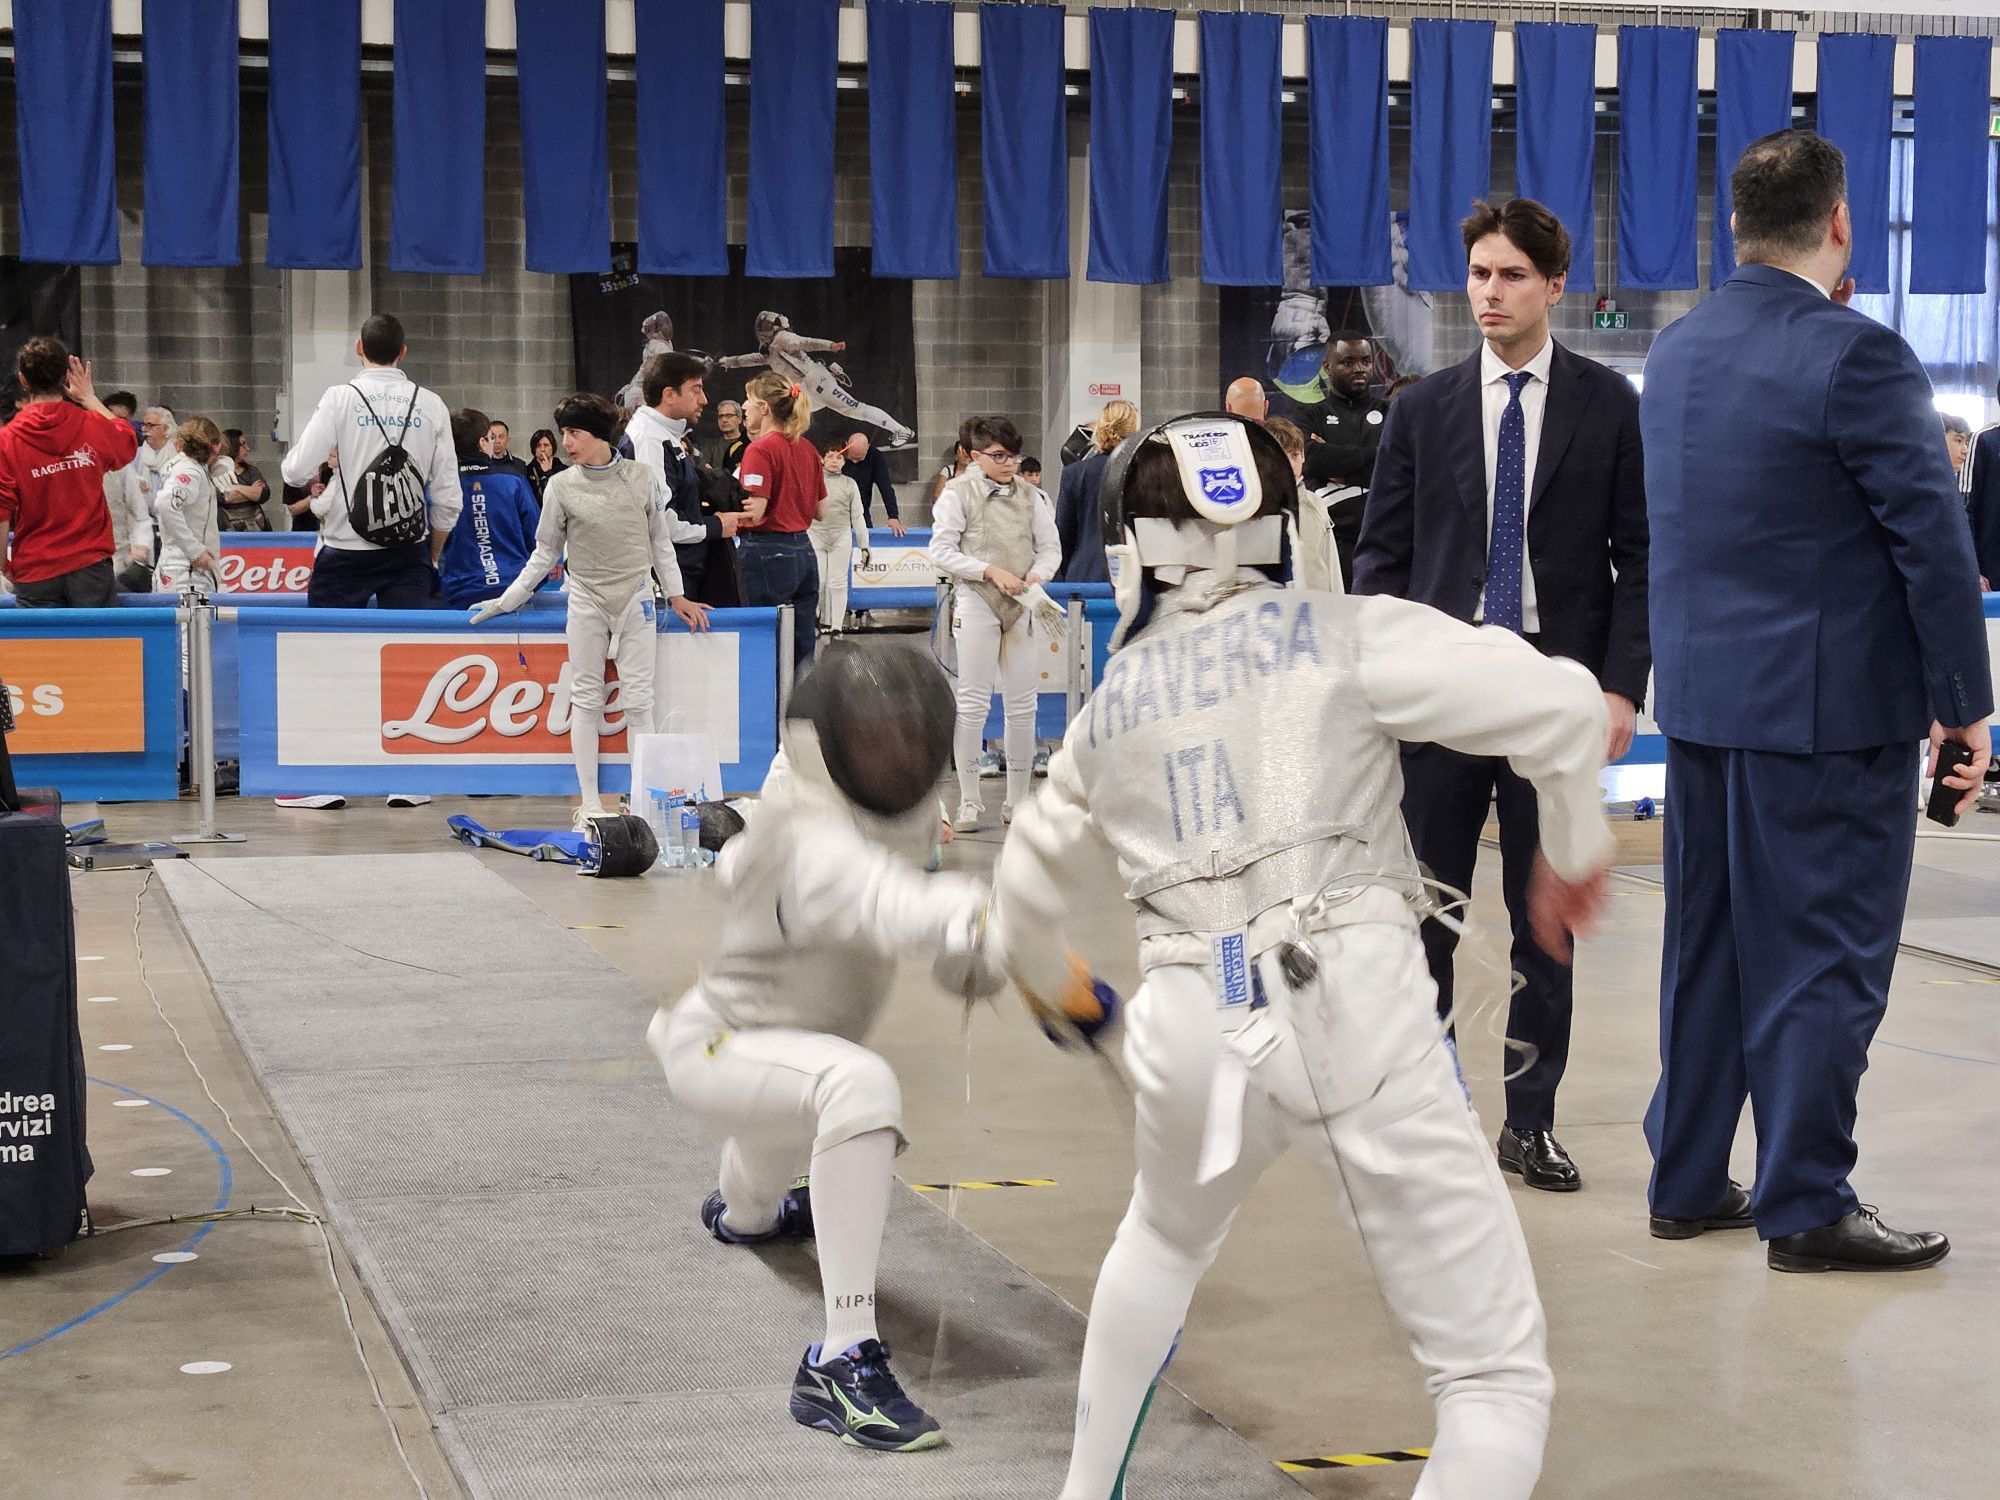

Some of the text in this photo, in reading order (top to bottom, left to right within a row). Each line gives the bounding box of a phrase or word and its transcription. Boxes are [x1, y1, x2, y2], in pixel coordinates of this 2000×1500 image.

[377, 393, 422, 415] SCHERA
[357, 415, 422, 428] CHVASO
[1163, 739, 1246, 842] ITA
[1230, 935, 1247, 1002] NEGRINI
[0, 1091, 55, 1114] drea
